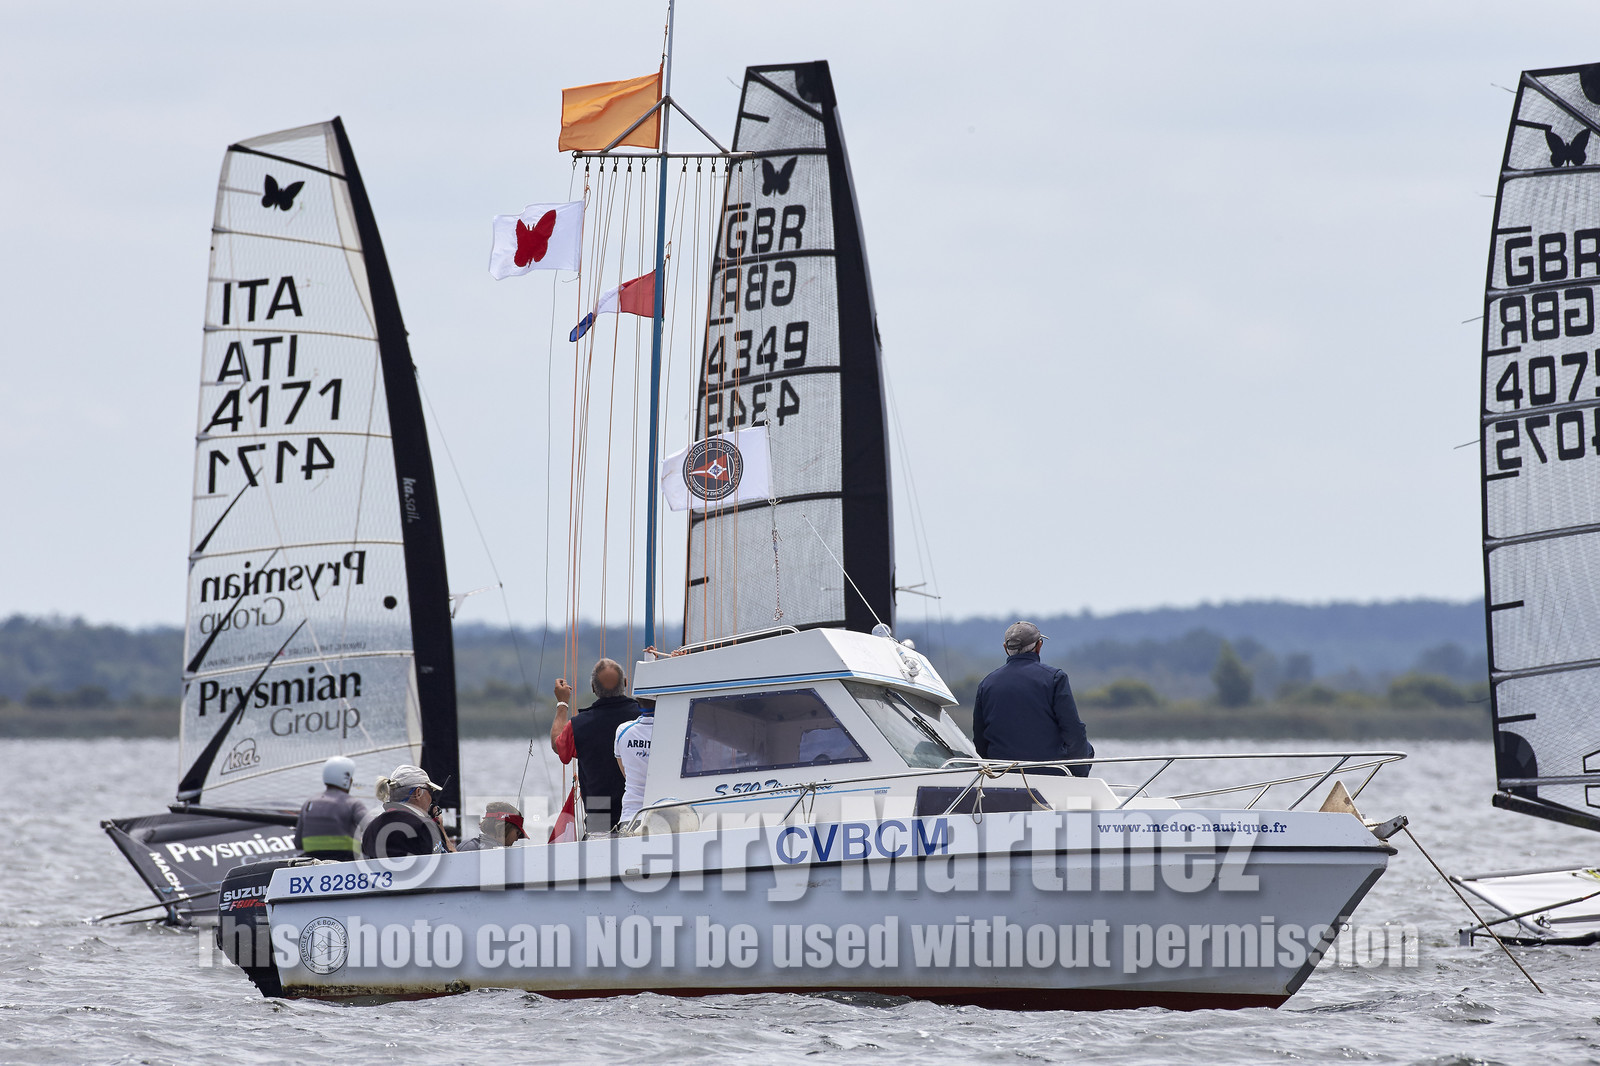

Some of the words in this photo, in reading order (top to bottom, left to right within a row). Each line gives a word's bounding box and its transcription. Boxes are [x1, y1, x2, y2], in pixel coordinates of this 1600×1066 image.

[726, 204, 806, 258] GBR
[1505, 228, 1600, 286] GBR
[222, 275, 303, 325] ITA
[707, 321, 809, 382] 4349
[211, 378, 342, 432] 4171
[1496, 348, 1600, 410] 407
[199, 667, 361, 726] Prysmian
[270, 707, 361, 738] Group
[776, 818, 948, 864] CVBCM
[1098, 821, 1287, 835] www.medoc-nautique.fr
[149, 851, 184, 892] MACH
[289, 876, 314, 894] BX
[320, 871, 393, 892] 828873
